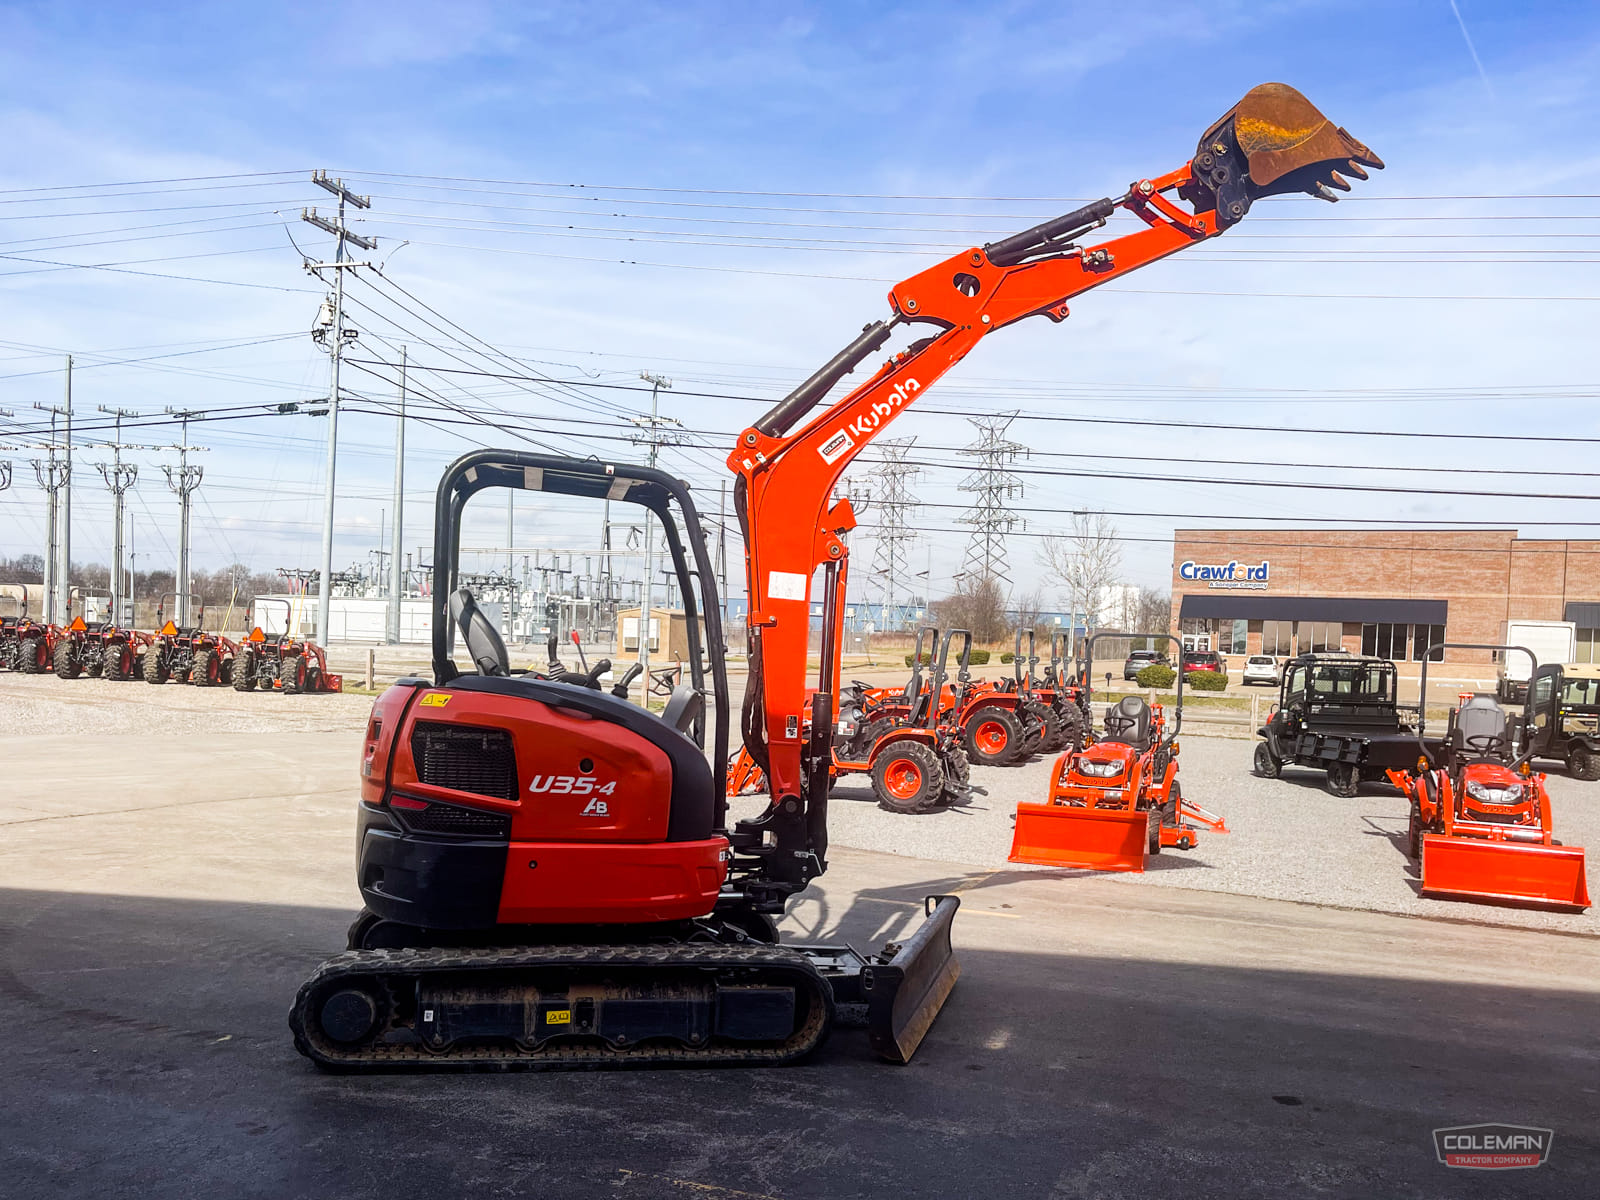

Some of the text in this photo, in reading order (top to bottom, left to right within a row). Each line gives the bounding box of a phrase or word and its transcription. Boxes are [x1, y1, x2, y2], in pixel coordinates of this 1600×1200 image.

[849, 378, 920, 437] Kubota
[1180, 562, 1268, 580] Crawford
[529, 775, 617, 796] U35-4
